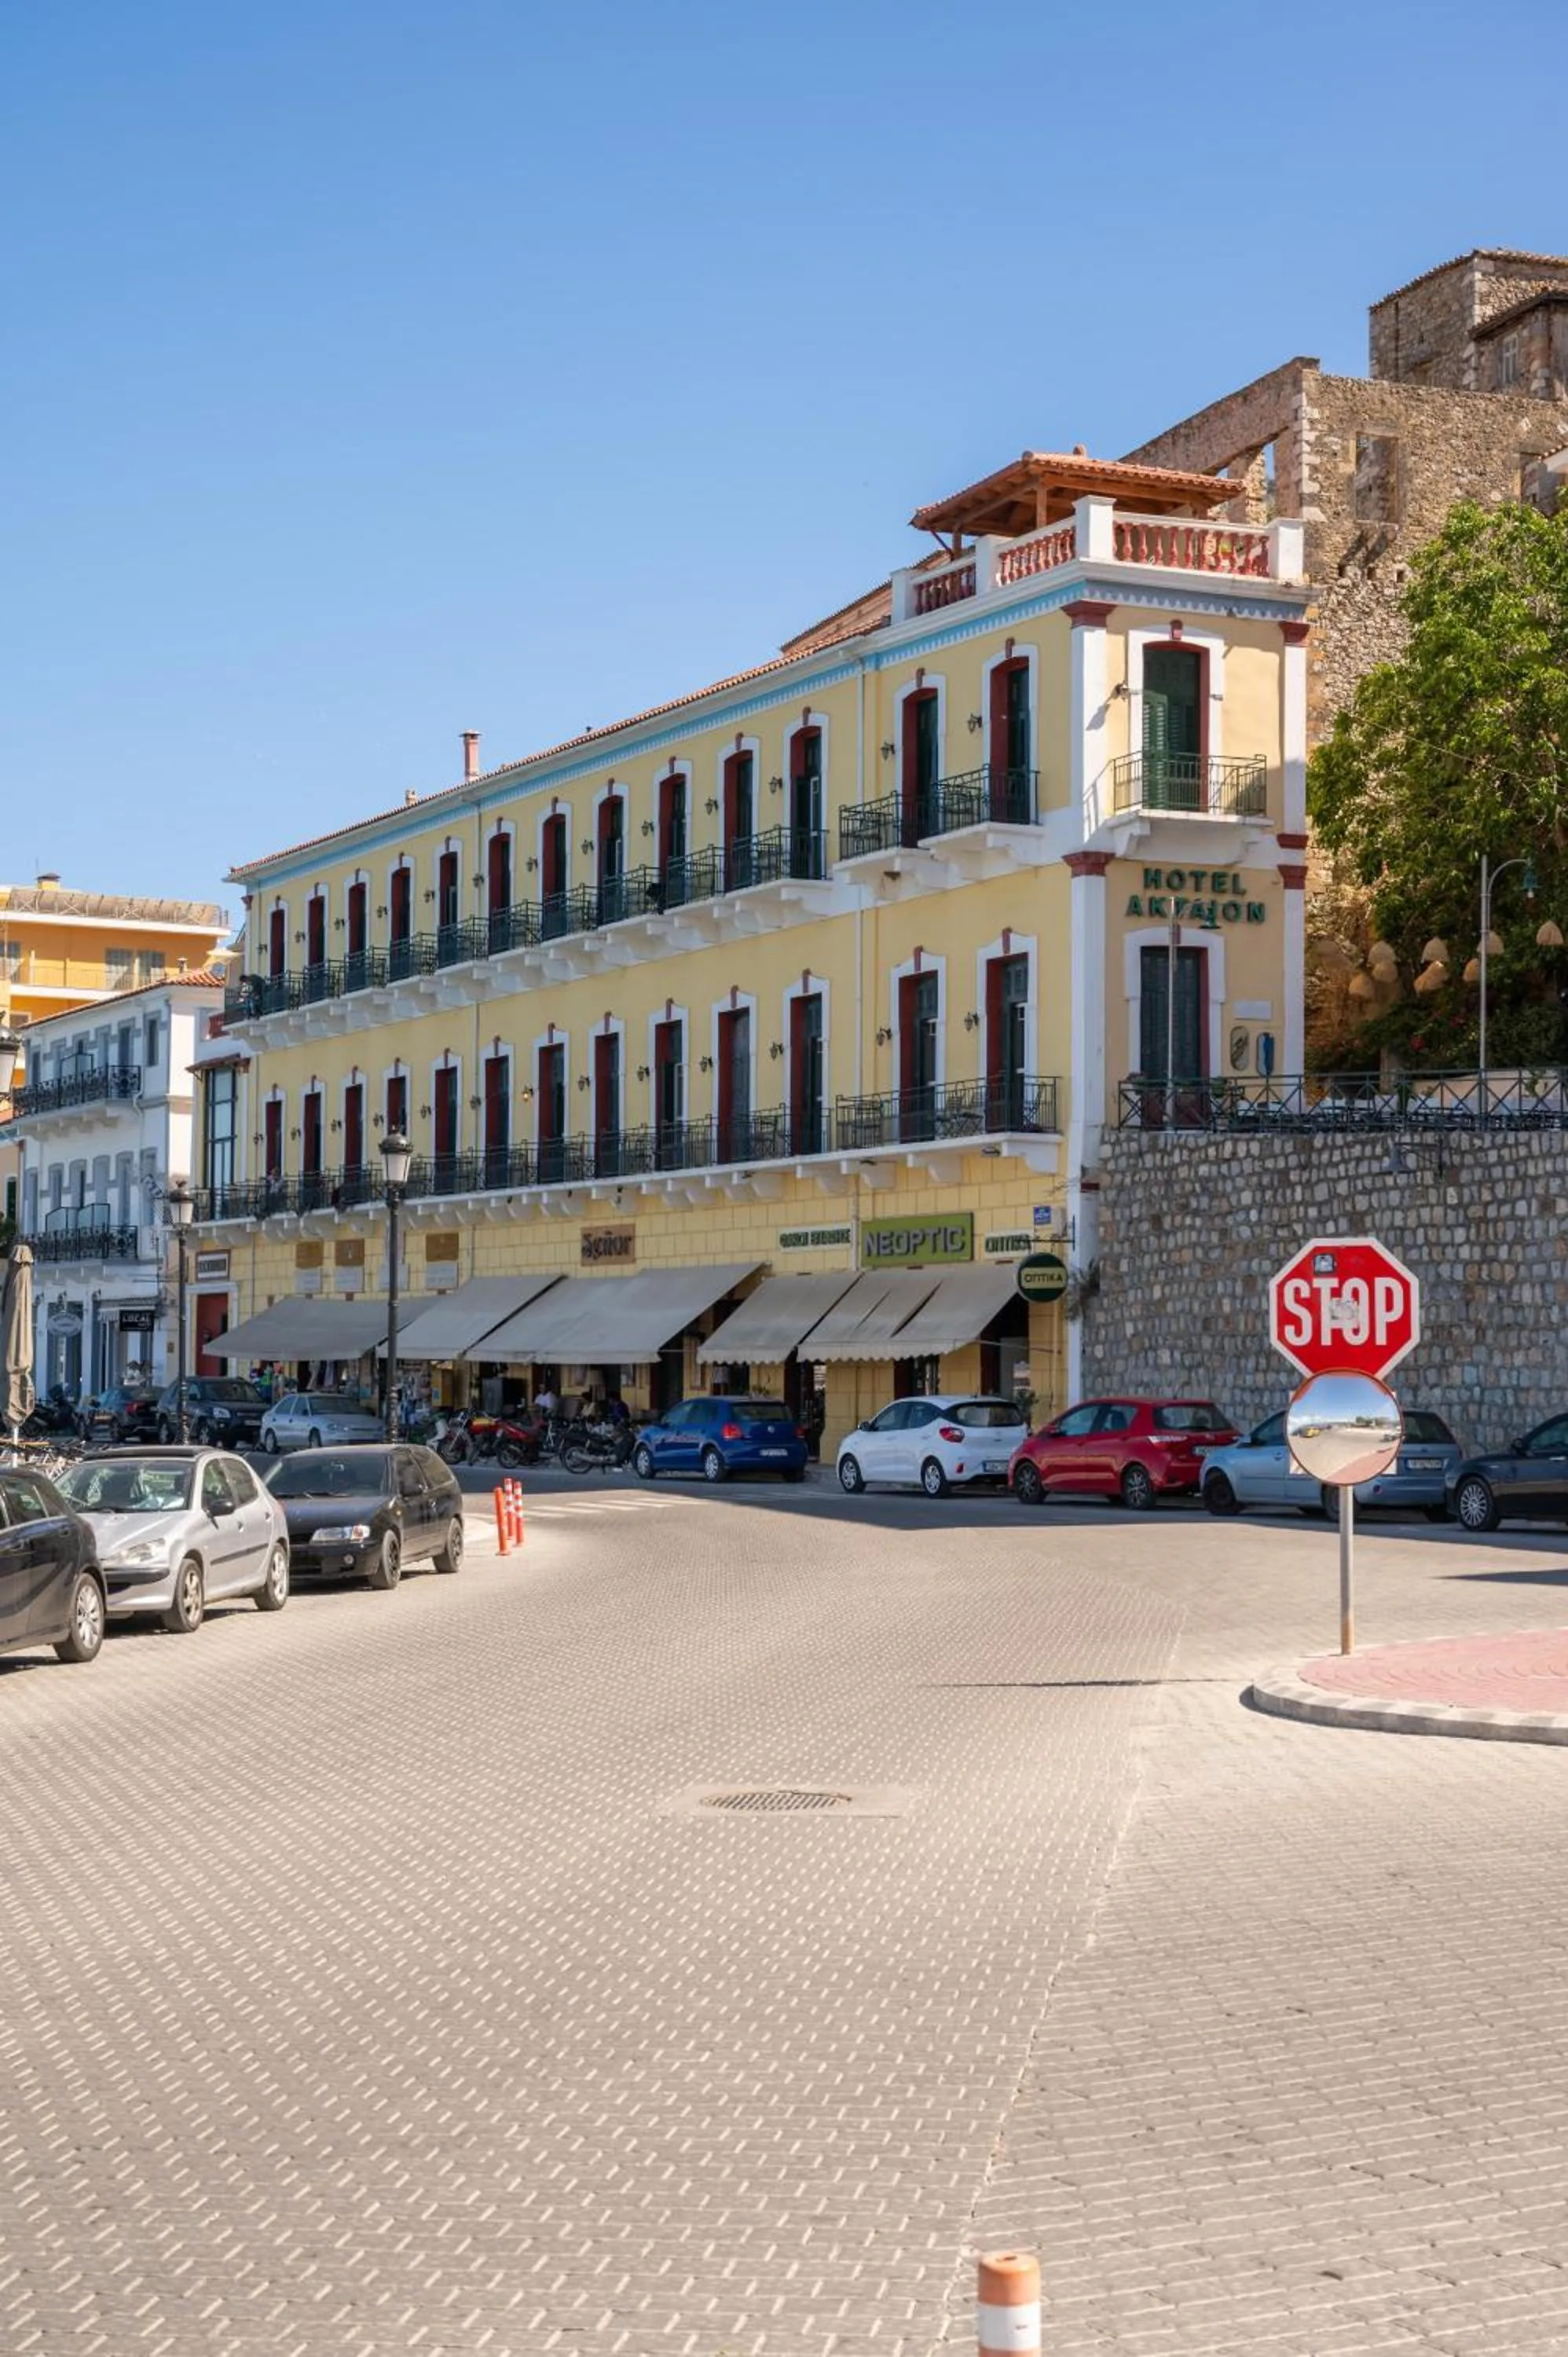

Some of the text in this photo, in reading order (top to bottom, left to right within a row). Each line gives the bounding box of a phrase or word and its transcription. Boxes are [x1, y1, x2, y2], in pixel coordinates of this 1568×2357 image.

[1143, 867, 1247, 896] HOTEL
[866, 1226, 966, 1256] NEOPTIC
[1024, 1274, 1063, 1283] ΟΠΤΙΚΑ
[1284, 1277, 1405, 1346] STOP
